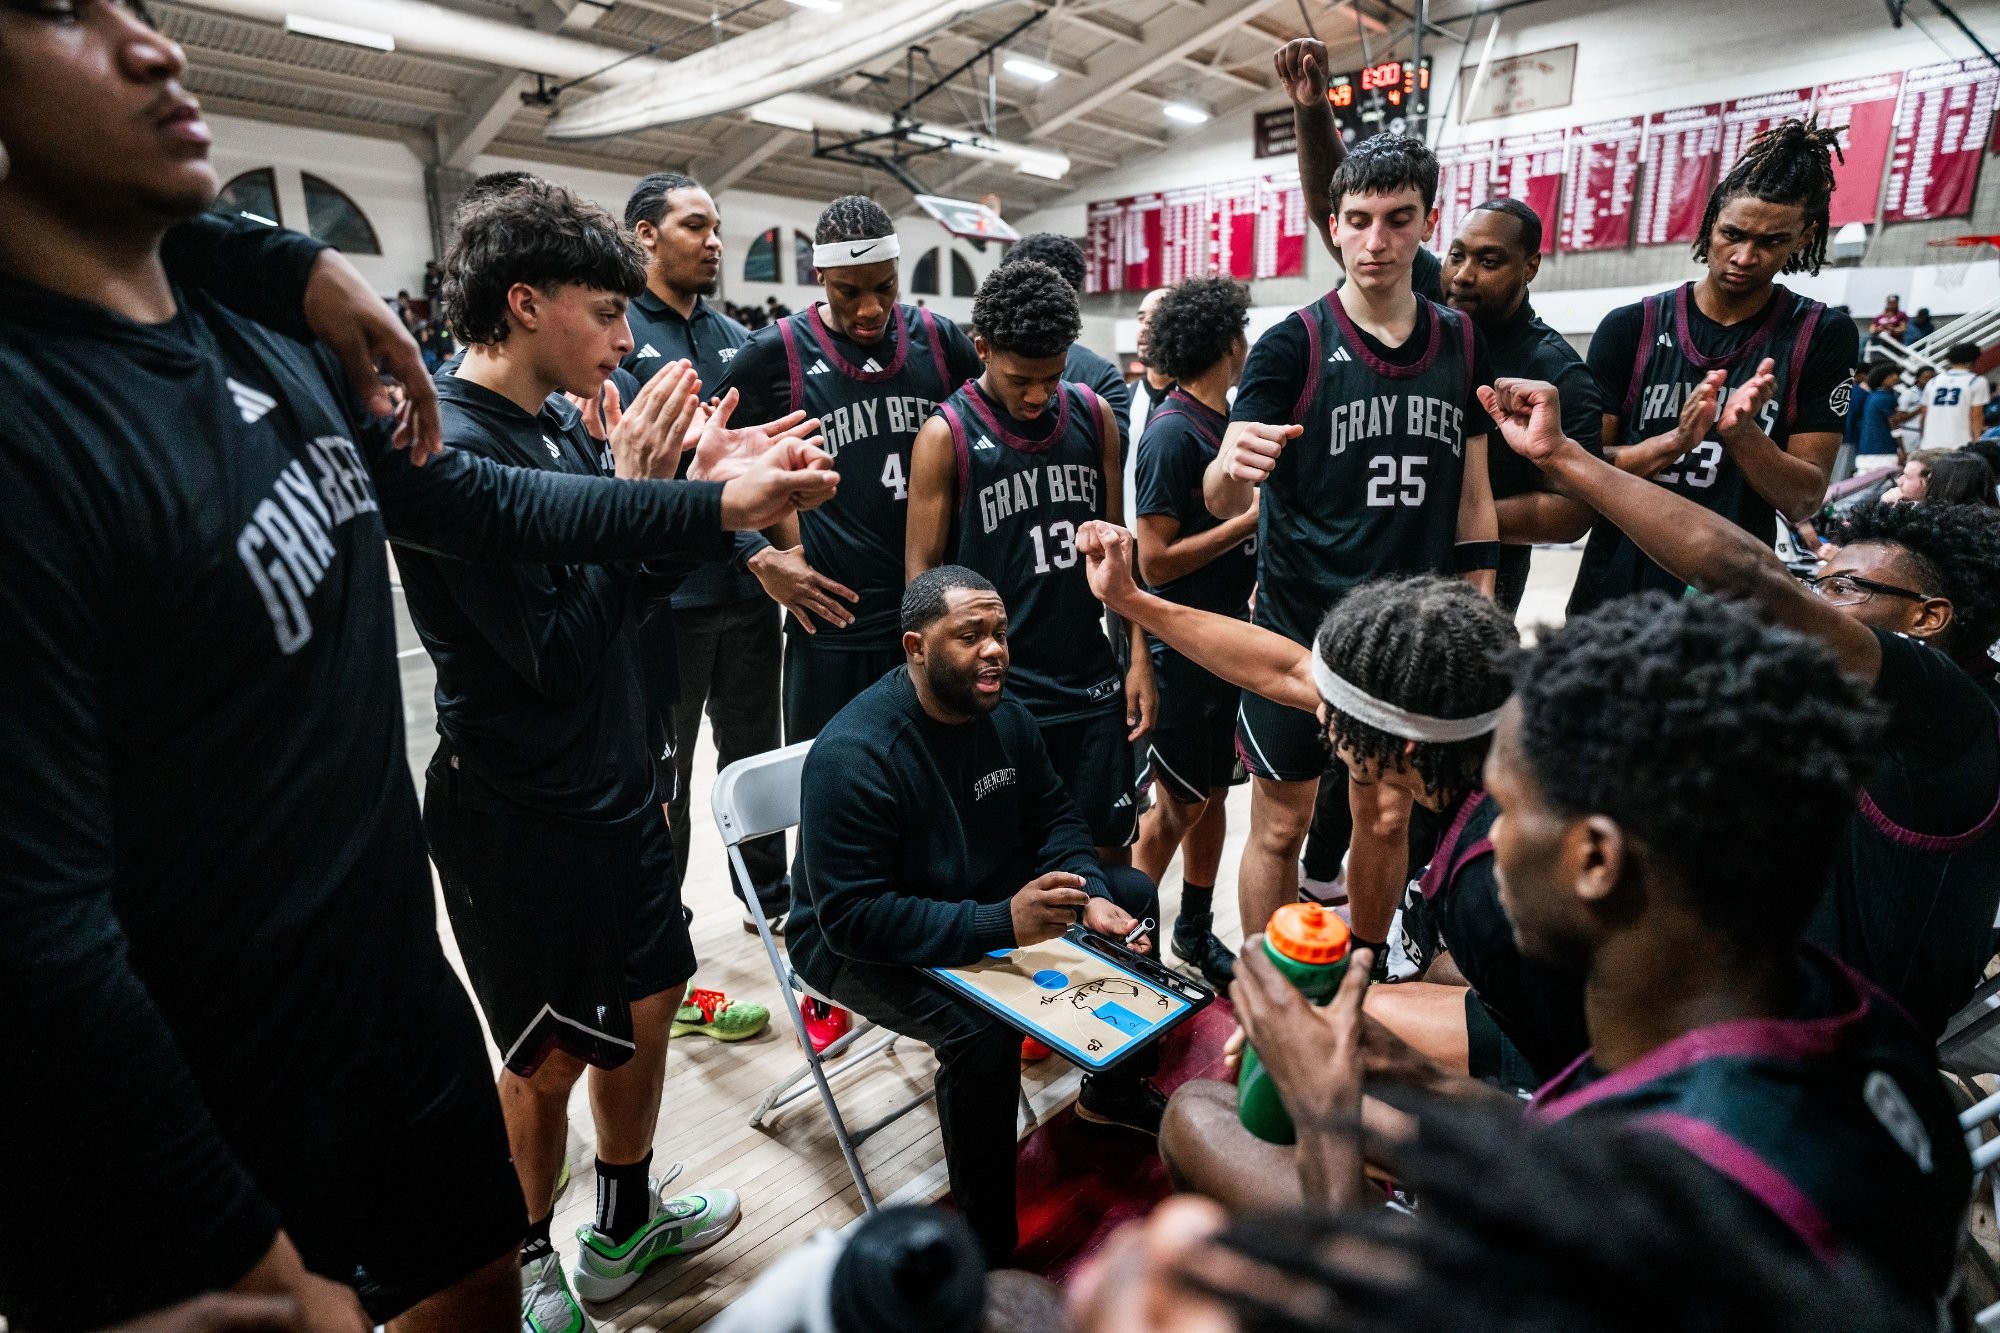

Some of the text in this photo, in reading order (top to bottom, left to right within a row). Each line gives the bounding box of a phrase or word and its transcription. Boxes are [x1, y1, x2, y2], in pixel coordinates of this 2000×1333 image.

[1934, 387, 1962, 406] 23
[820, 396, 939, 459] GRAY BEE
[1330, 395, 1464, 458] GRAY BEES
[881, 452, 908, 500] 4
[979, 464, 1098, 534] GRAY BEES
[1366, 455, 1429, 507] 25
[236, 458, 337, 655] GRAY
[1029, 520, 1078, 574] 13
